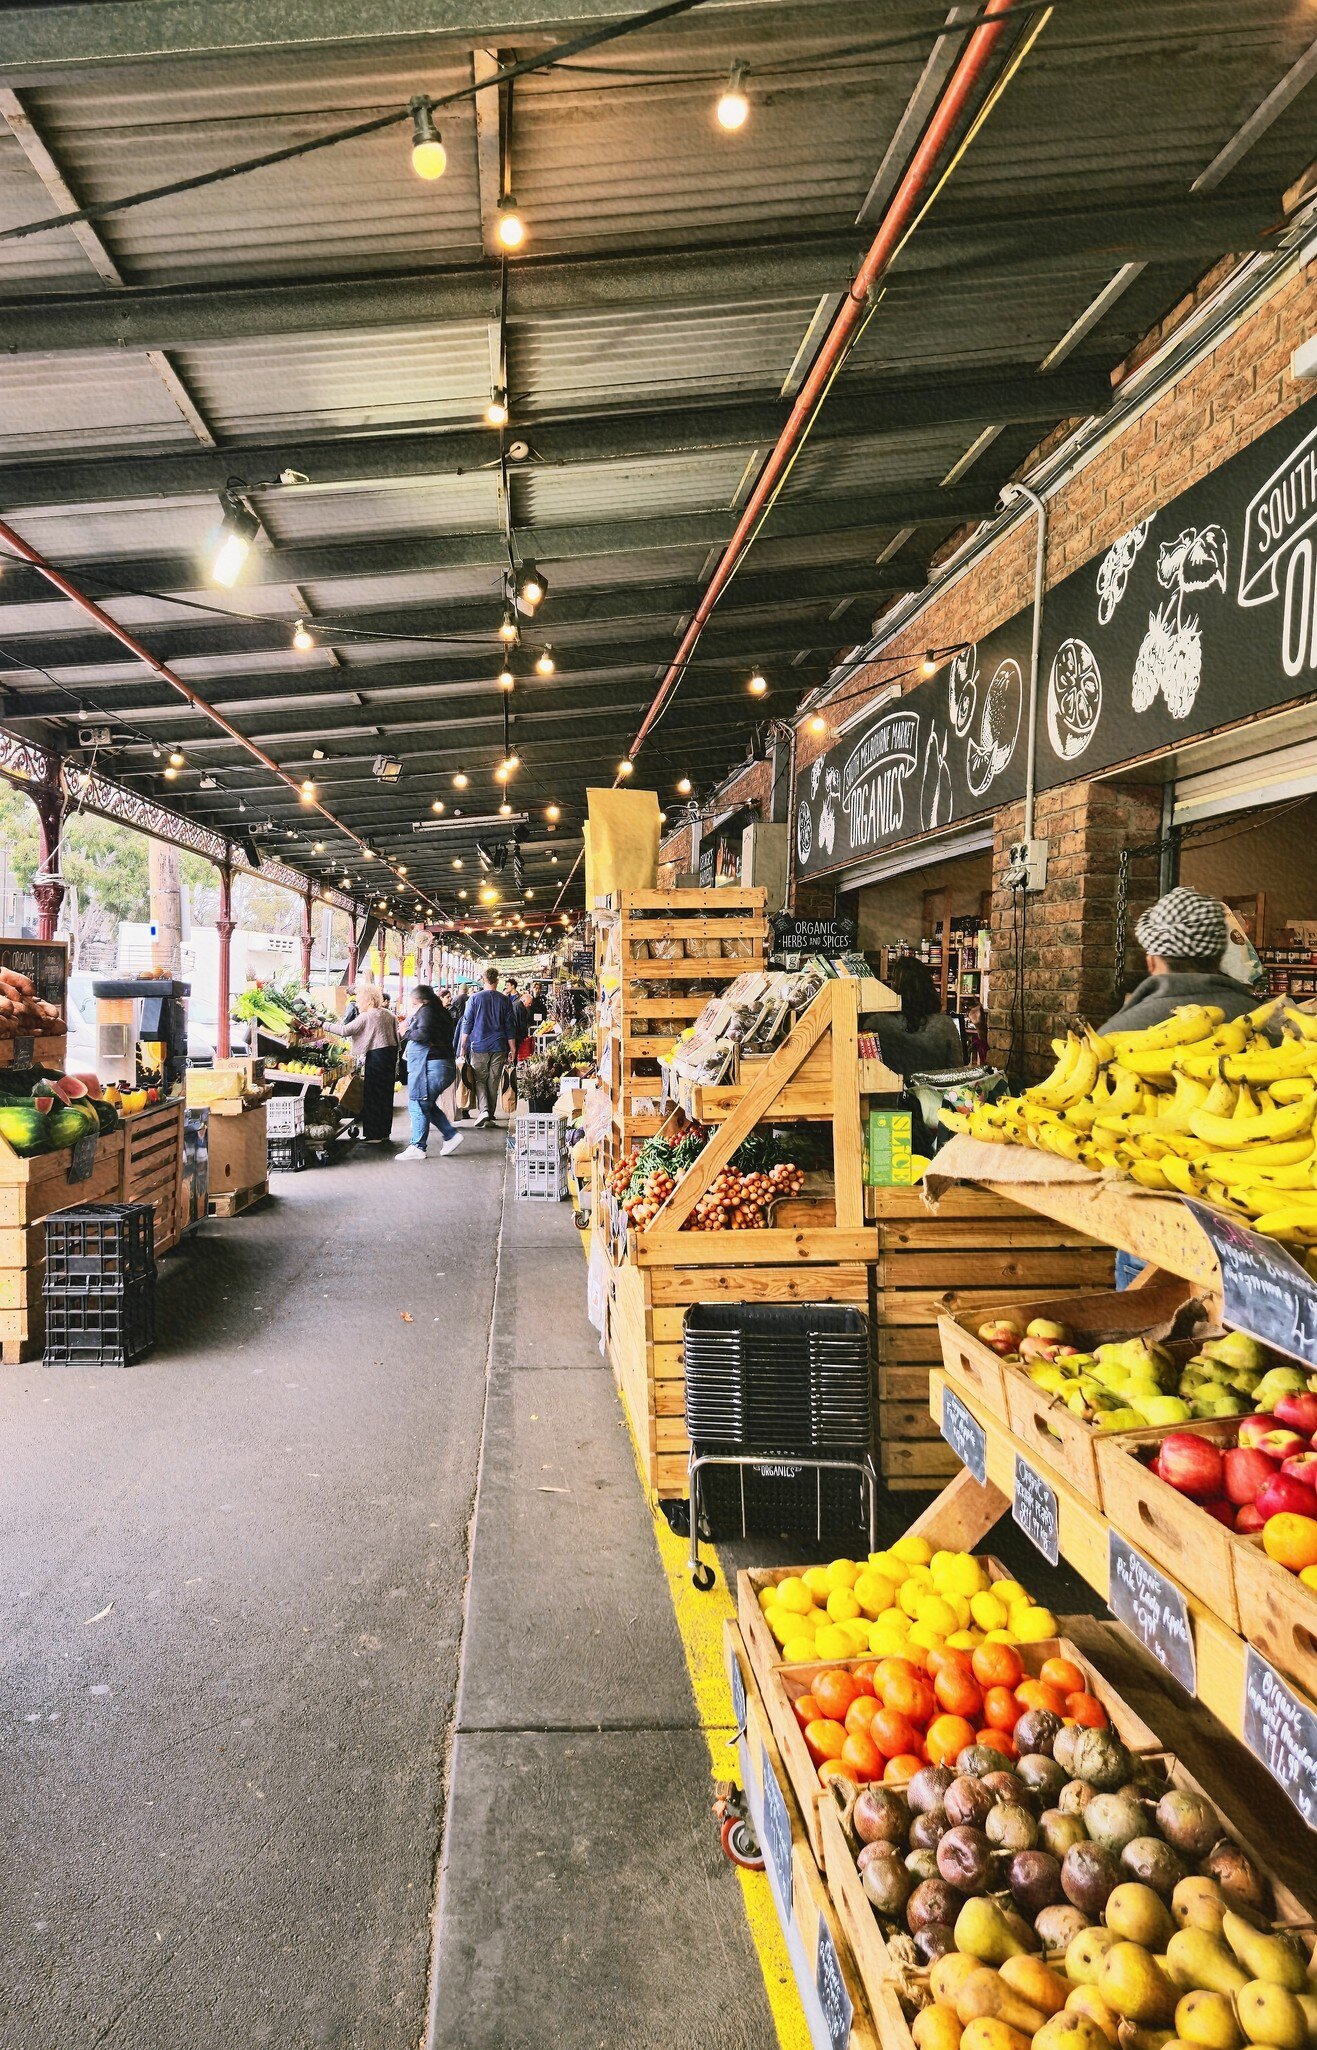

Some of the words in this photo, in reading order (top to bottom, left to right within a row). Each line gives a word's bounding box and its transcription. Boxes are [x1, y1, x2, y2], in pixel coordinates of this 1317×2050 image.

[1283, 538, 1317, 677] O
[891, 721, 915, 750] MARKET
[850, 763, 904, 848] ORGANICS
[782, 935, 808, 948] HERBS
[822, 935, 849, 948] SPICES
[795, 921, 837, 935] ORGANIC
[760, 1465, 795, 1478] ORGANICS
[1262, 1671, 1302, 1731] Organic
